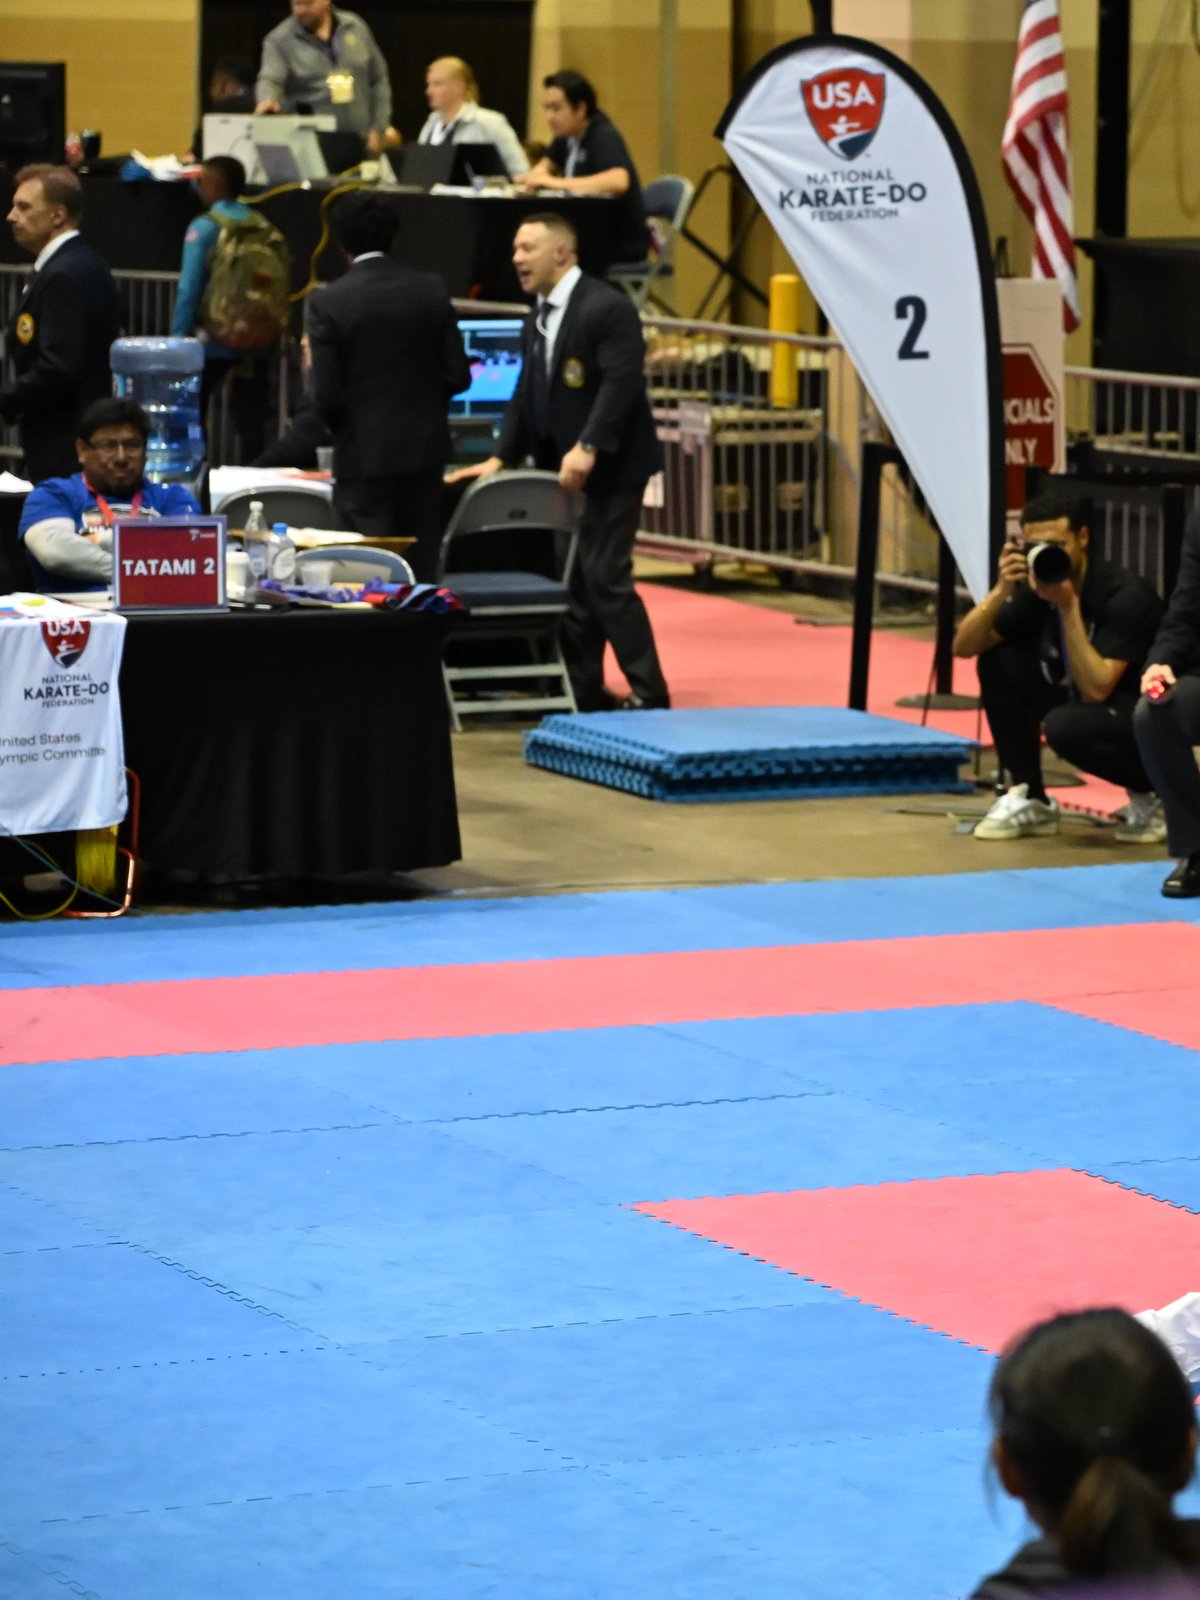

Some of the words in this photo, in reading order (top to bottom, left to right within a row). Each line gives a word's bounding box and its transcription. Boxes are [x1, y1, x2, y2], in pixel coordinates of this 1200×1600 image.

[812, 81, 876, 109] USA
[807, 169, 894, 185] NATIONAL
[779, 182, 927, 210] KARATE-DO
[811, 208, 898, 222] FEDERATION
[895, 295, 929, 360] 2
[1003, 398, 1054, 425] ICIALS
[1005, 438, 1038, 465] NLY
[122, 559, 195, 576] TATAMI
[203, 557, 215, 574] 2
[46, 619, 85, 636] USA
[42, 673, 93, 684] NATIONAL
[24, 682, 110, 700] KARATE-DO
[41, 698, 94, 708] FEDERATION
[0, 736, 36, 748] nited
[40, 733, 81, 745] States
[0, 752, 39, 766] ympic
